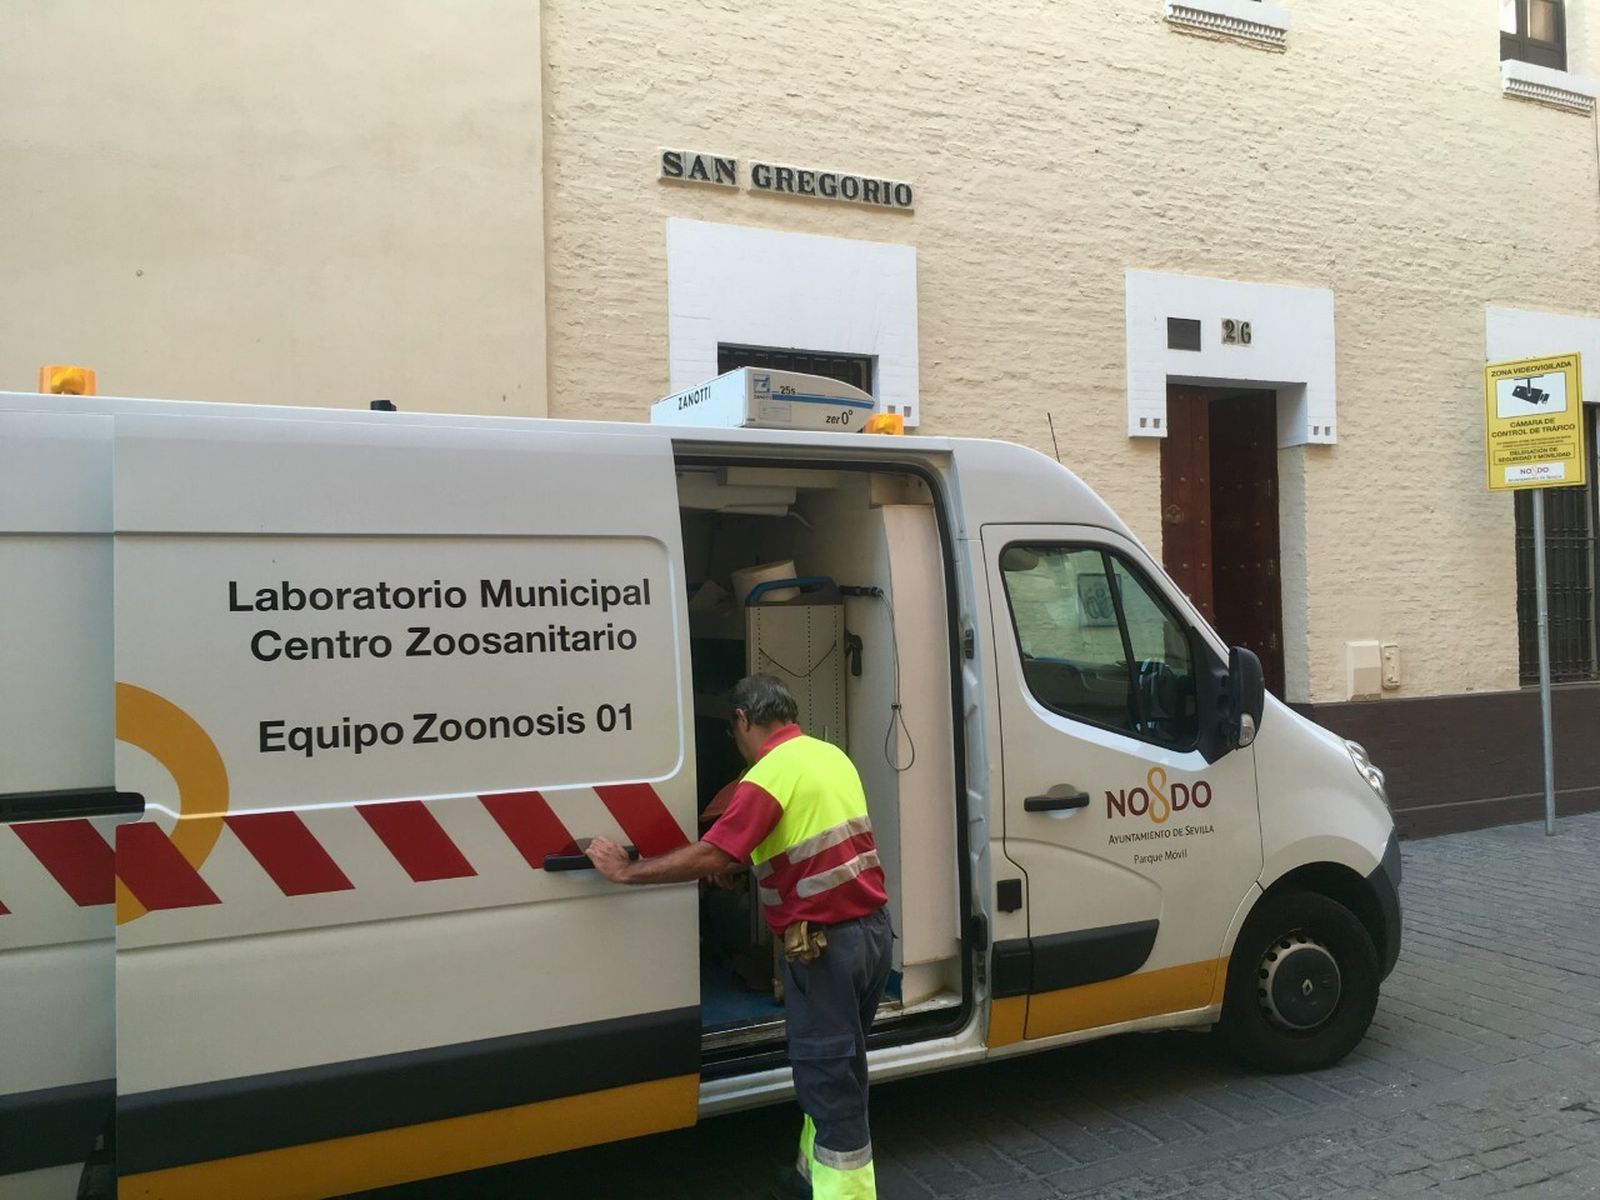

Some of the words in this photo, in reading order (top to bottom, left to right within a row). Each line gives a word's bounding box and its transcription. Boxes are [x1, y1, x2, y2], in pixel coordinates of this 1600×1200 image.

[662, 150, 737, 185] SAN
[751, 163, 913, 207] GREGORIO
[1222, 318, 1252, 344] 26
[1491, 367, 1512, 377] ZONA
[1514, 361, 1572, 374] VIDEOVIGILADA
[678, 385, 711, 410] ZANOTTI
[1491, 428, 1527, 438] CONTROL
[1544, 417, 1555, 425] DE
[228, 579, 467, 612] Laboratorio
[480, 578, 651, 612] Municipal
[250, 629, 392, 662] Centro
[405, 623, 637, 657] Zoosanitario
[259, 717, 404, 758] Equipo
[412, 706, 586, 744] Zoonosis
[596, 703, 633, 733] 01
[1108, 829, 1171, 845] AYUNTAMIENTO
[1172, 828, 1184, 837] DE
[1185, 825, 1215, 836] SEVILLA
[1134, 854, 1163, 865] Parque
[1165, 848, 1187, 861] Móvil
